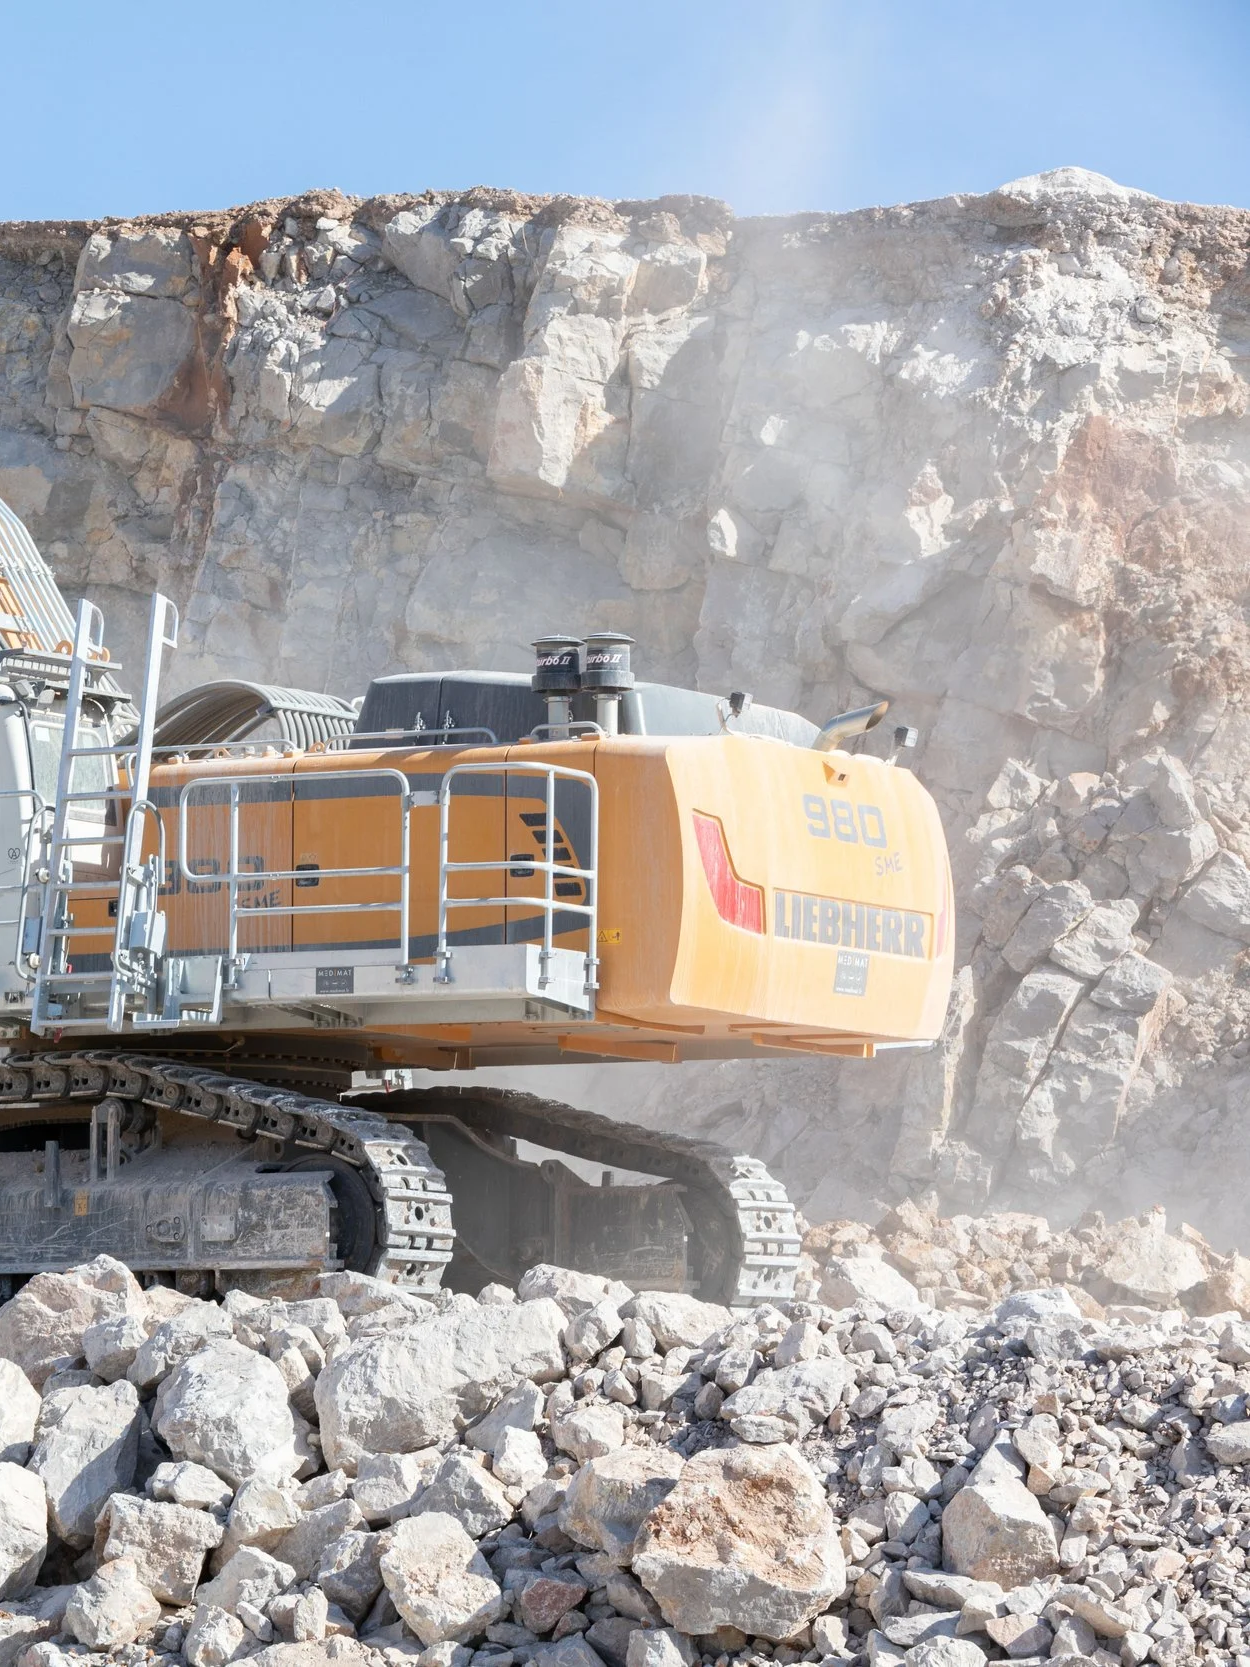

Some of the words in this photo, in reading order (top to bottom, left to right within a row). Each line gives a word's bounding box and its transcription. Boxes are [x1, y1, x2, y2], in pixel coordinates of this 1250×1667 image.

[803, 794, 887, 848] 980
[876, 853, 903, 876] SME
[775, 892, 925, 959] LIEBHERR
[318, 969, 352, 977] MEDIMAT
